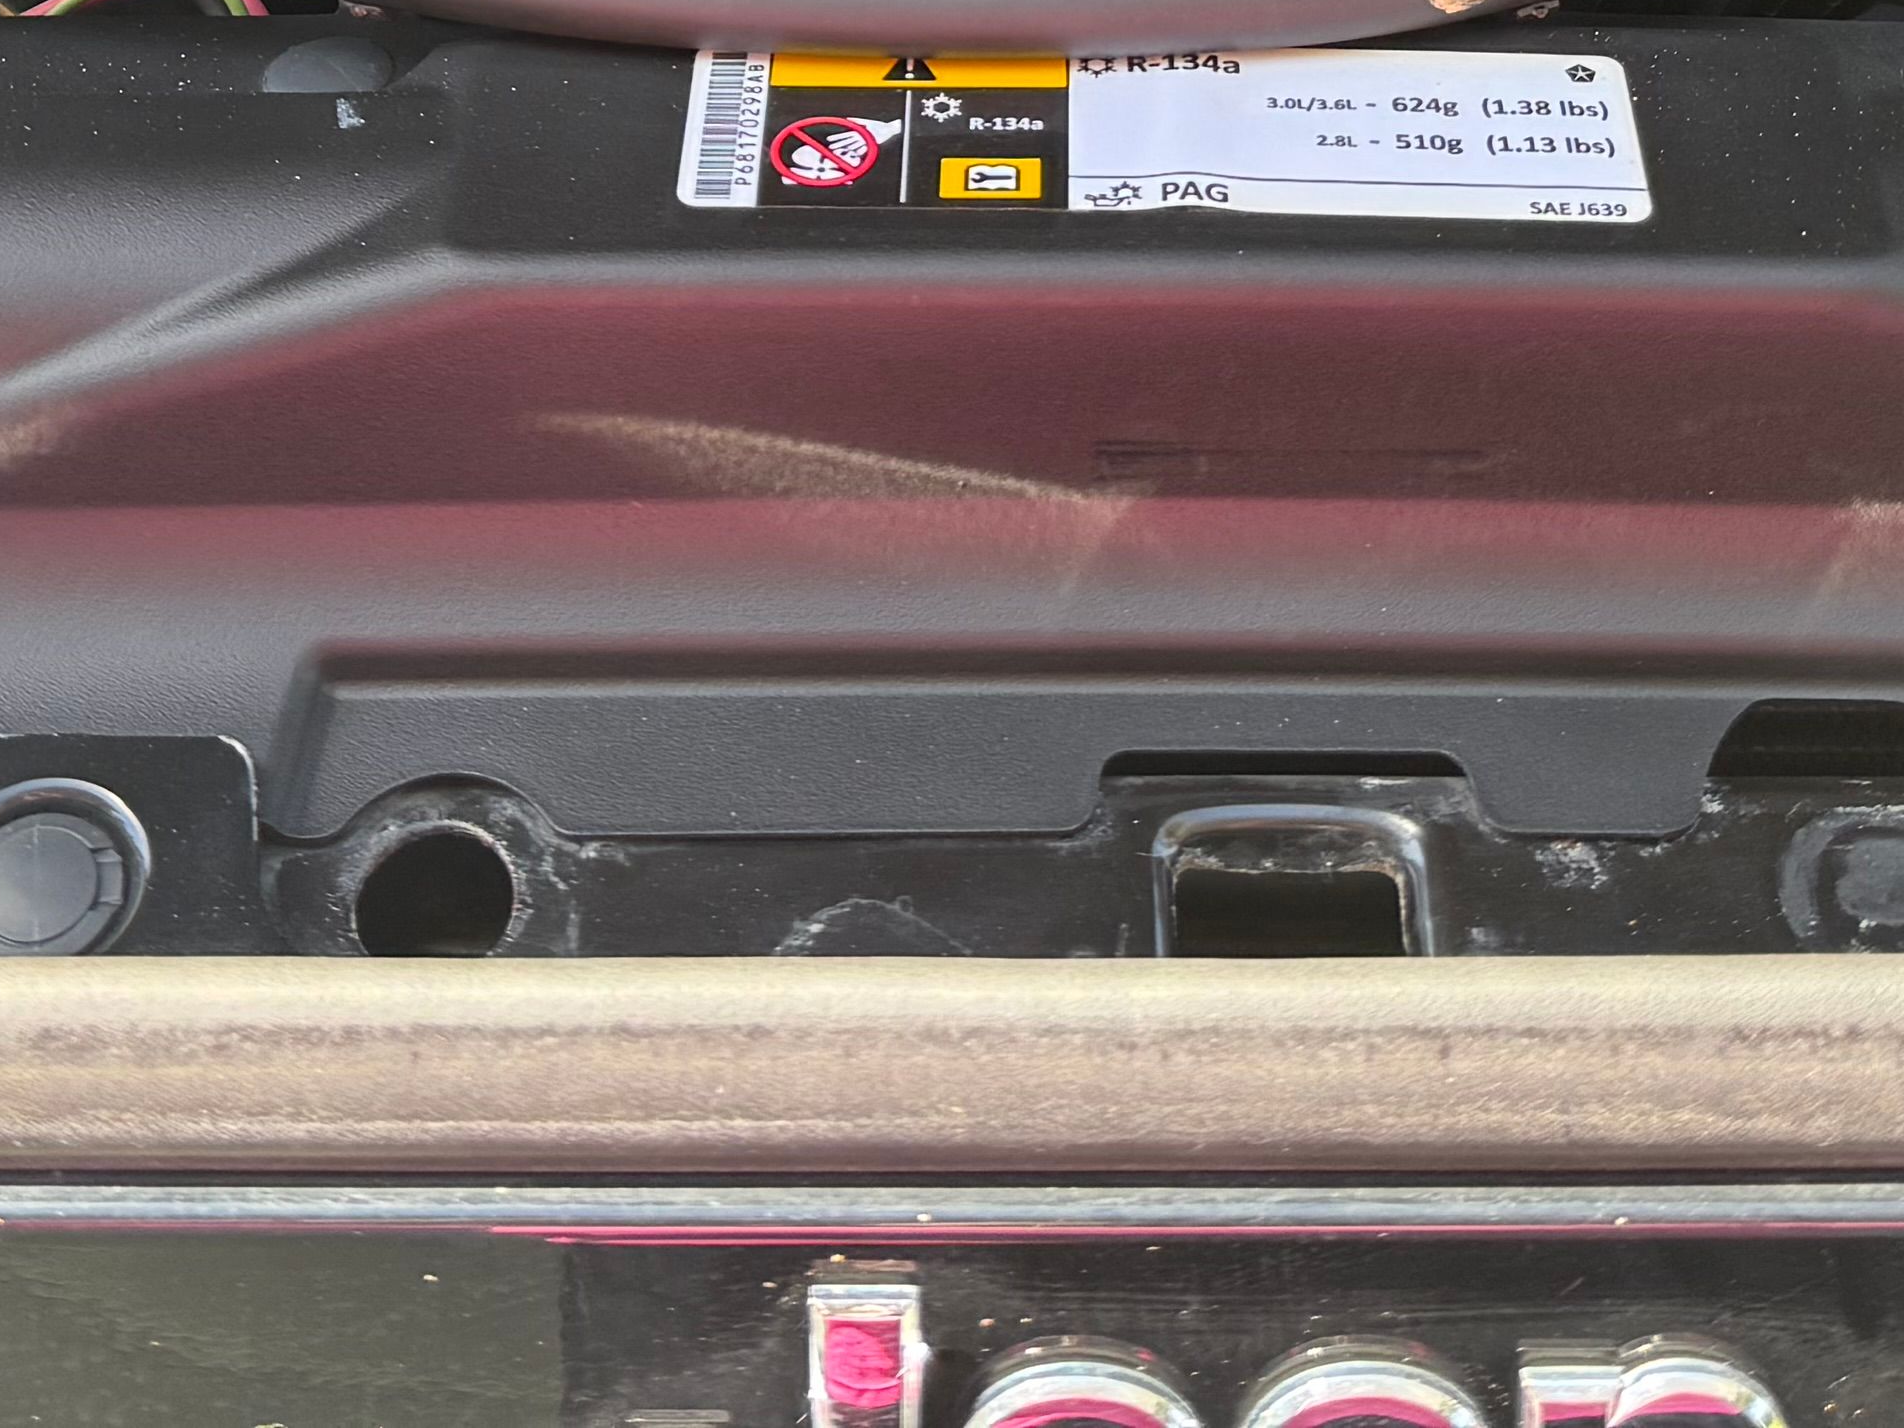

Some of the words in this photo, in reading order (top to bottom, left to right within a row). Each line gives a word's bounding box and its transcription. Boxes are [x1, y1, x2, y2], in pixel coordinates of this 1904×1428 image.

[1126, 54, 1242, 75] R-134a
[1266, 96, 1358, 112] 3.0L/3.6L
[1391, 96, 1460, 118] 624g
[1481, 97, 1552, 119] (1.38
[1559, 100, 1609, 122] lbs)
[734, 64, 765, 186] P68170298AB
[968, 117, 1045, 131] R-134a
[1316, 134, 1359, 148] 2.8L
[1395, 134, 1464, 155] 510g
[1486, 134, 1557, 156] (1.13
[1564, 136, 1616, 159] lbs)
[1160, 181, 1230, 203] PAG
[1529, 201, 1573, 216] SAE
[1577, 202, 1628, 217] J639
